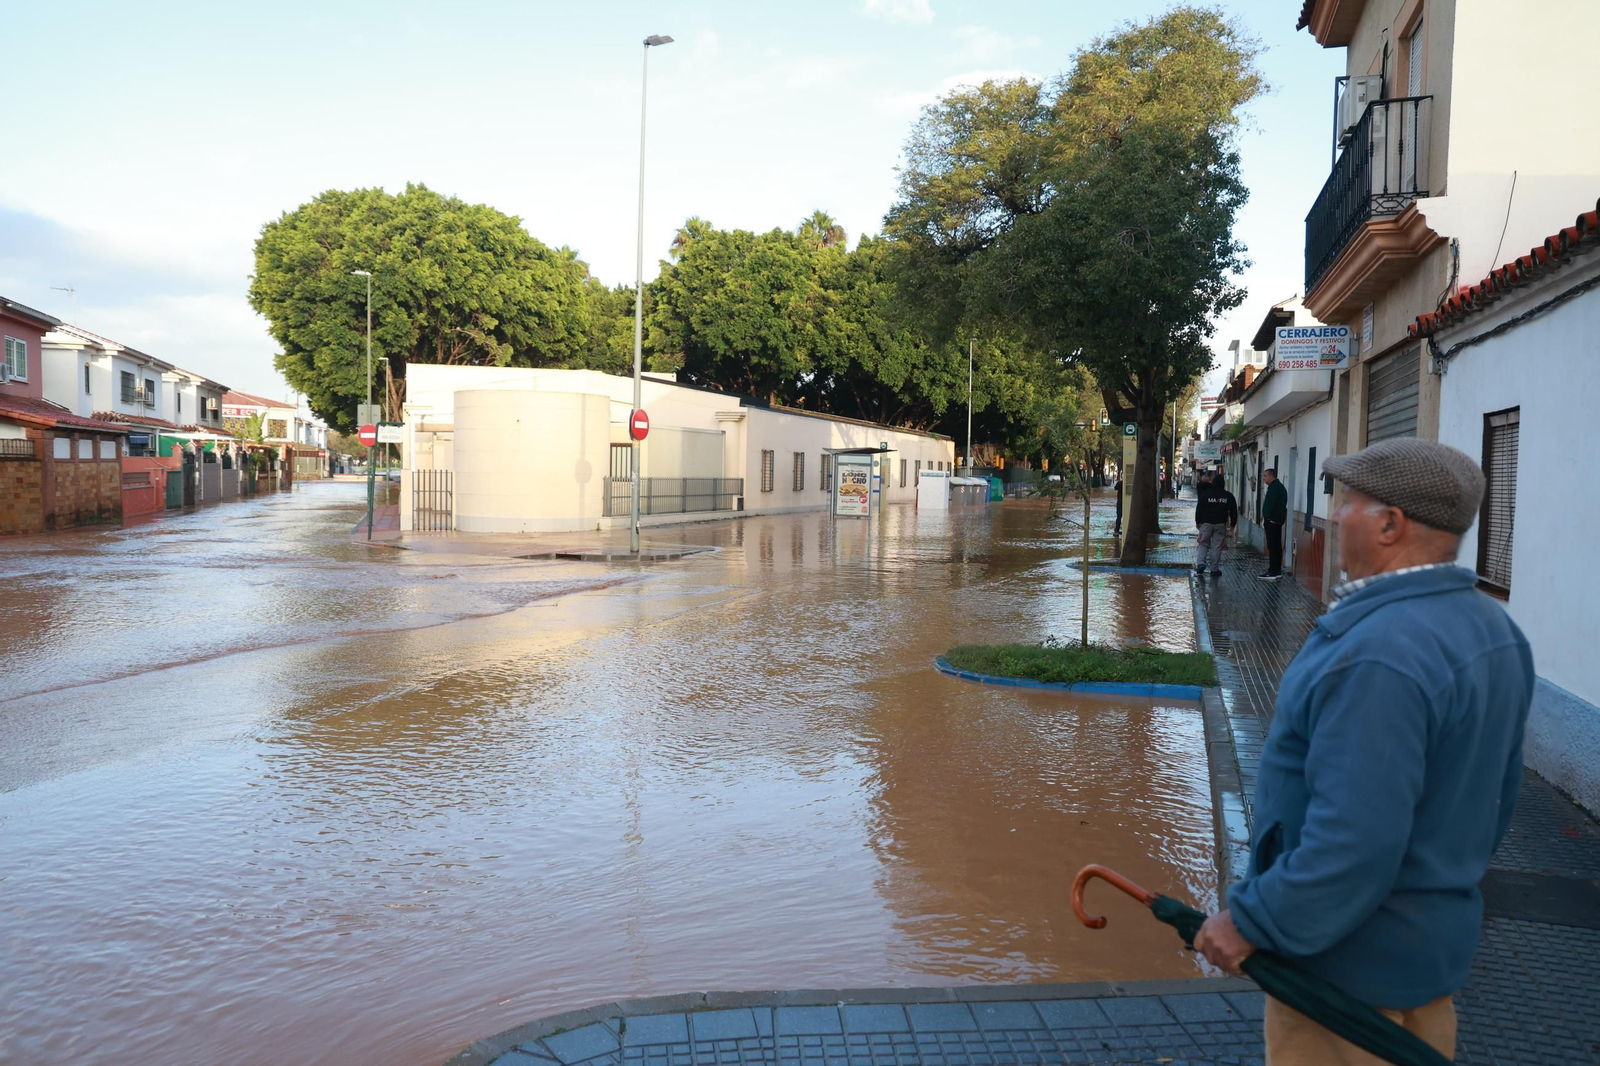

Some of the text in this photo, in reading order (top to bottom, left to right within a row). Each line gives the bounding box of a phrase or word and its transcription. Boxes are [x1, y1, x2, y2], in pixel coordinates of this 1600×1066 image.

[1278, 328, 1348, 338] CERRAJERO
[1278, 360, 1318, 368] 690 258 485
